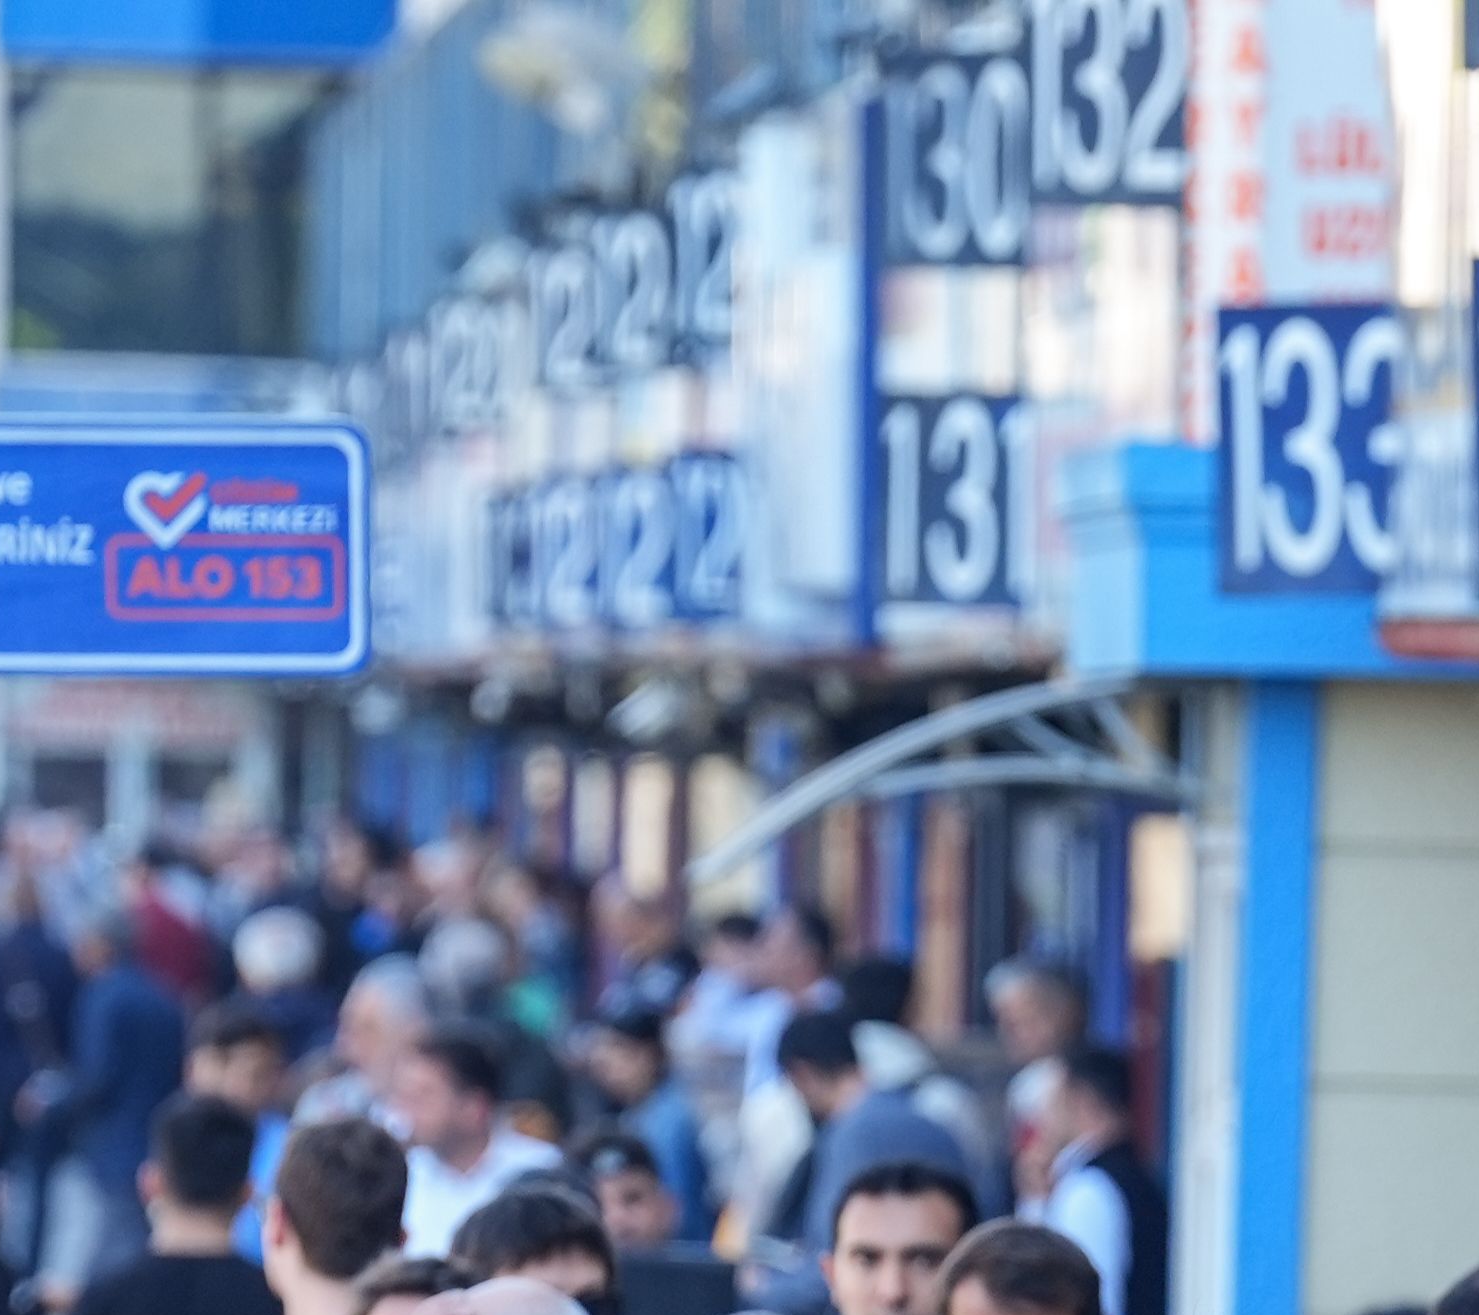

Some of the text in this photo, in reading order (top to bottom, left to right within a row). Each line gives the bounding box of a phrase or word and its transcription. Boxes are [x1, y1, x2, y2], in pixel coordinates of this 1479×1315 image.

[1031, 0, 1189, 192] 132
[879, 400, 1037, 602] 131
[1220, 317, 1400, 578] 133
[126, 554, 322, 600] ALO 153
